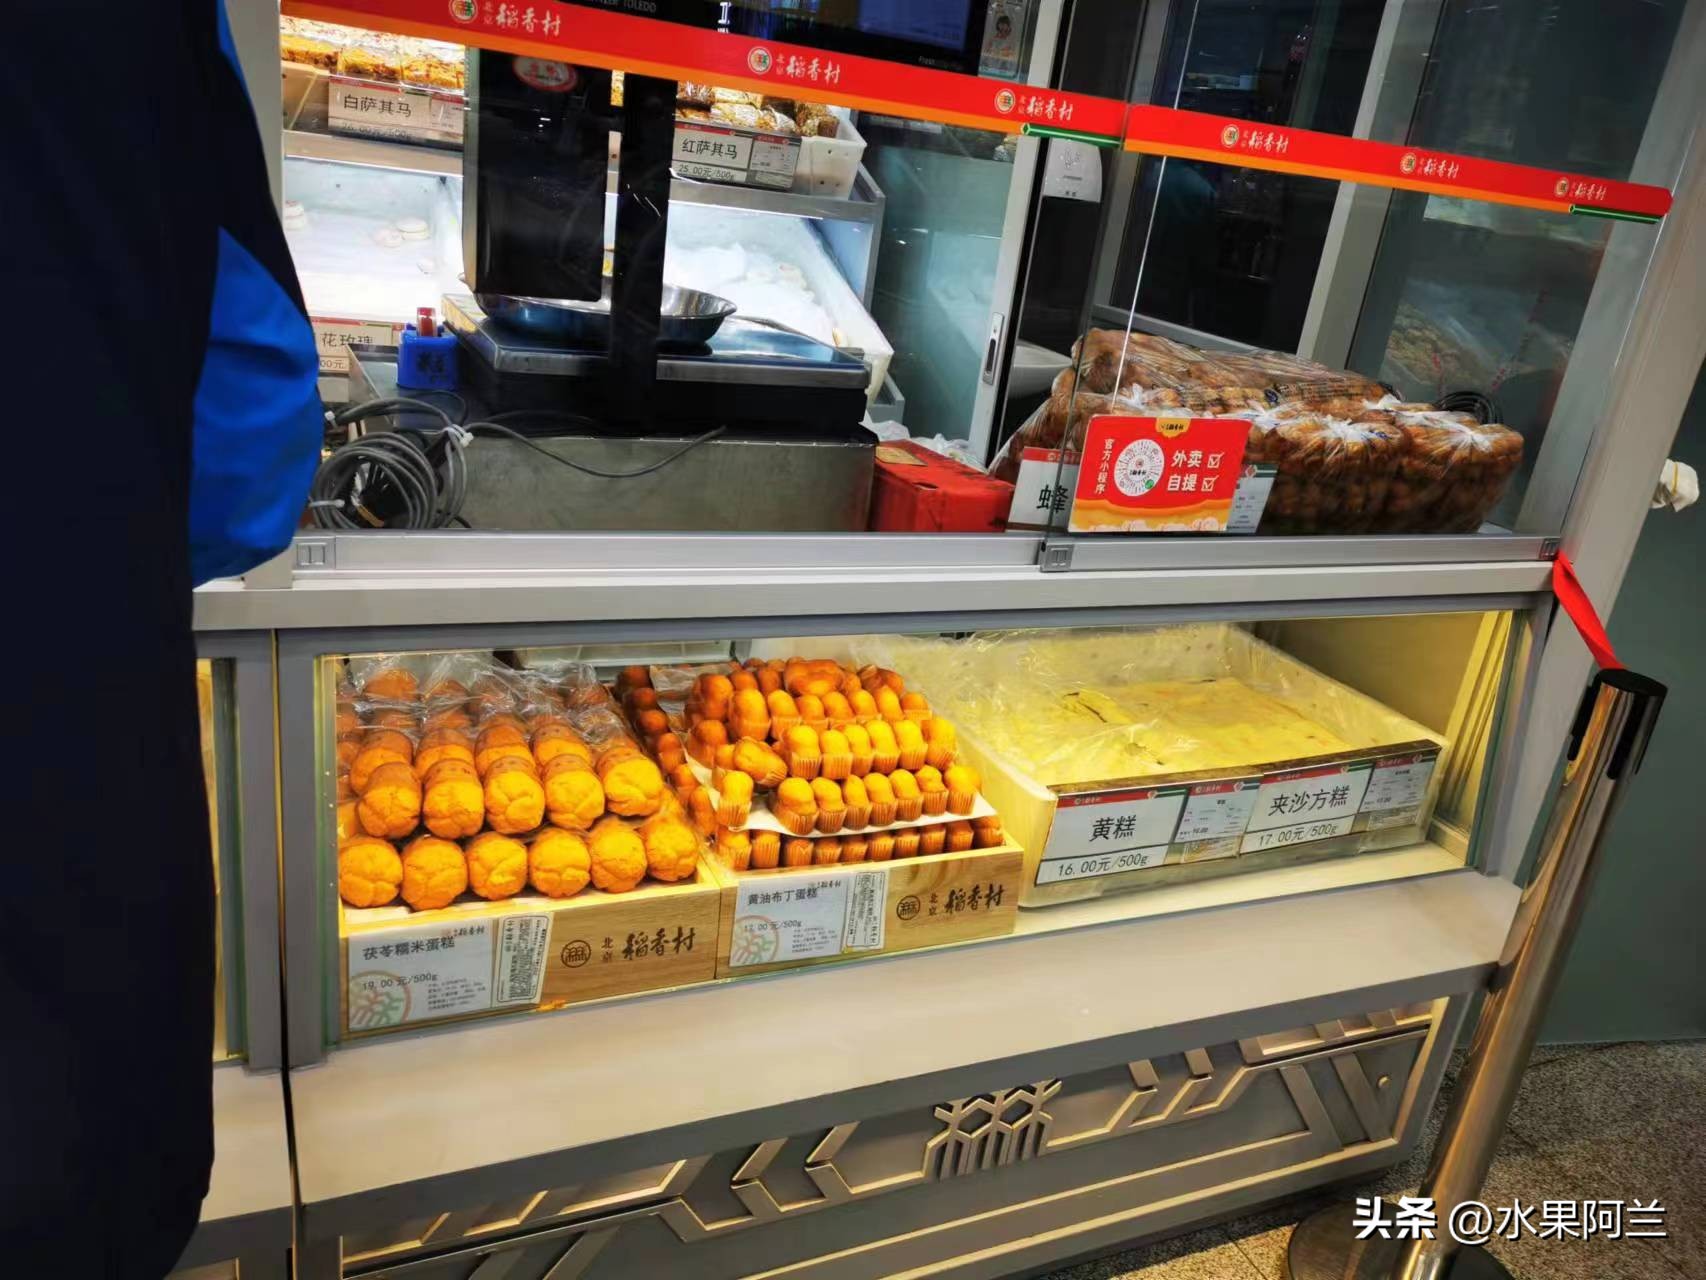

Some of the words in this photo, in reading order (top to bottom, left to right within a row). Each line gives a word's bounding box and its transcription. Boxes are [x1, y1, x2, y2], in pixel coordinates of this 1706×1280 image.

[495, 4, 561, 37] 稻香村
[786, 54, 841, 85] 稻香村
[343, 94, 412, 118] 白萨其马
[1027, 95, 1074, 121] 稻香村
[682, 138, 738, 159] 红萨其马
[1094, 438, 1116, 495] 官方小程序
[1171, 450, 1203, 468] 外卖
[1166, 473, 1198, 491] 自提
[1036, 484, 1070, 514] 蜂
[1267, 784, 1350, 817] 夹沙方糕
[1089, 814, 1137, 842] 黄糕
[944, 882, 1006, 915] 稻香村
[622, 926, 696, 961] 稻香村
